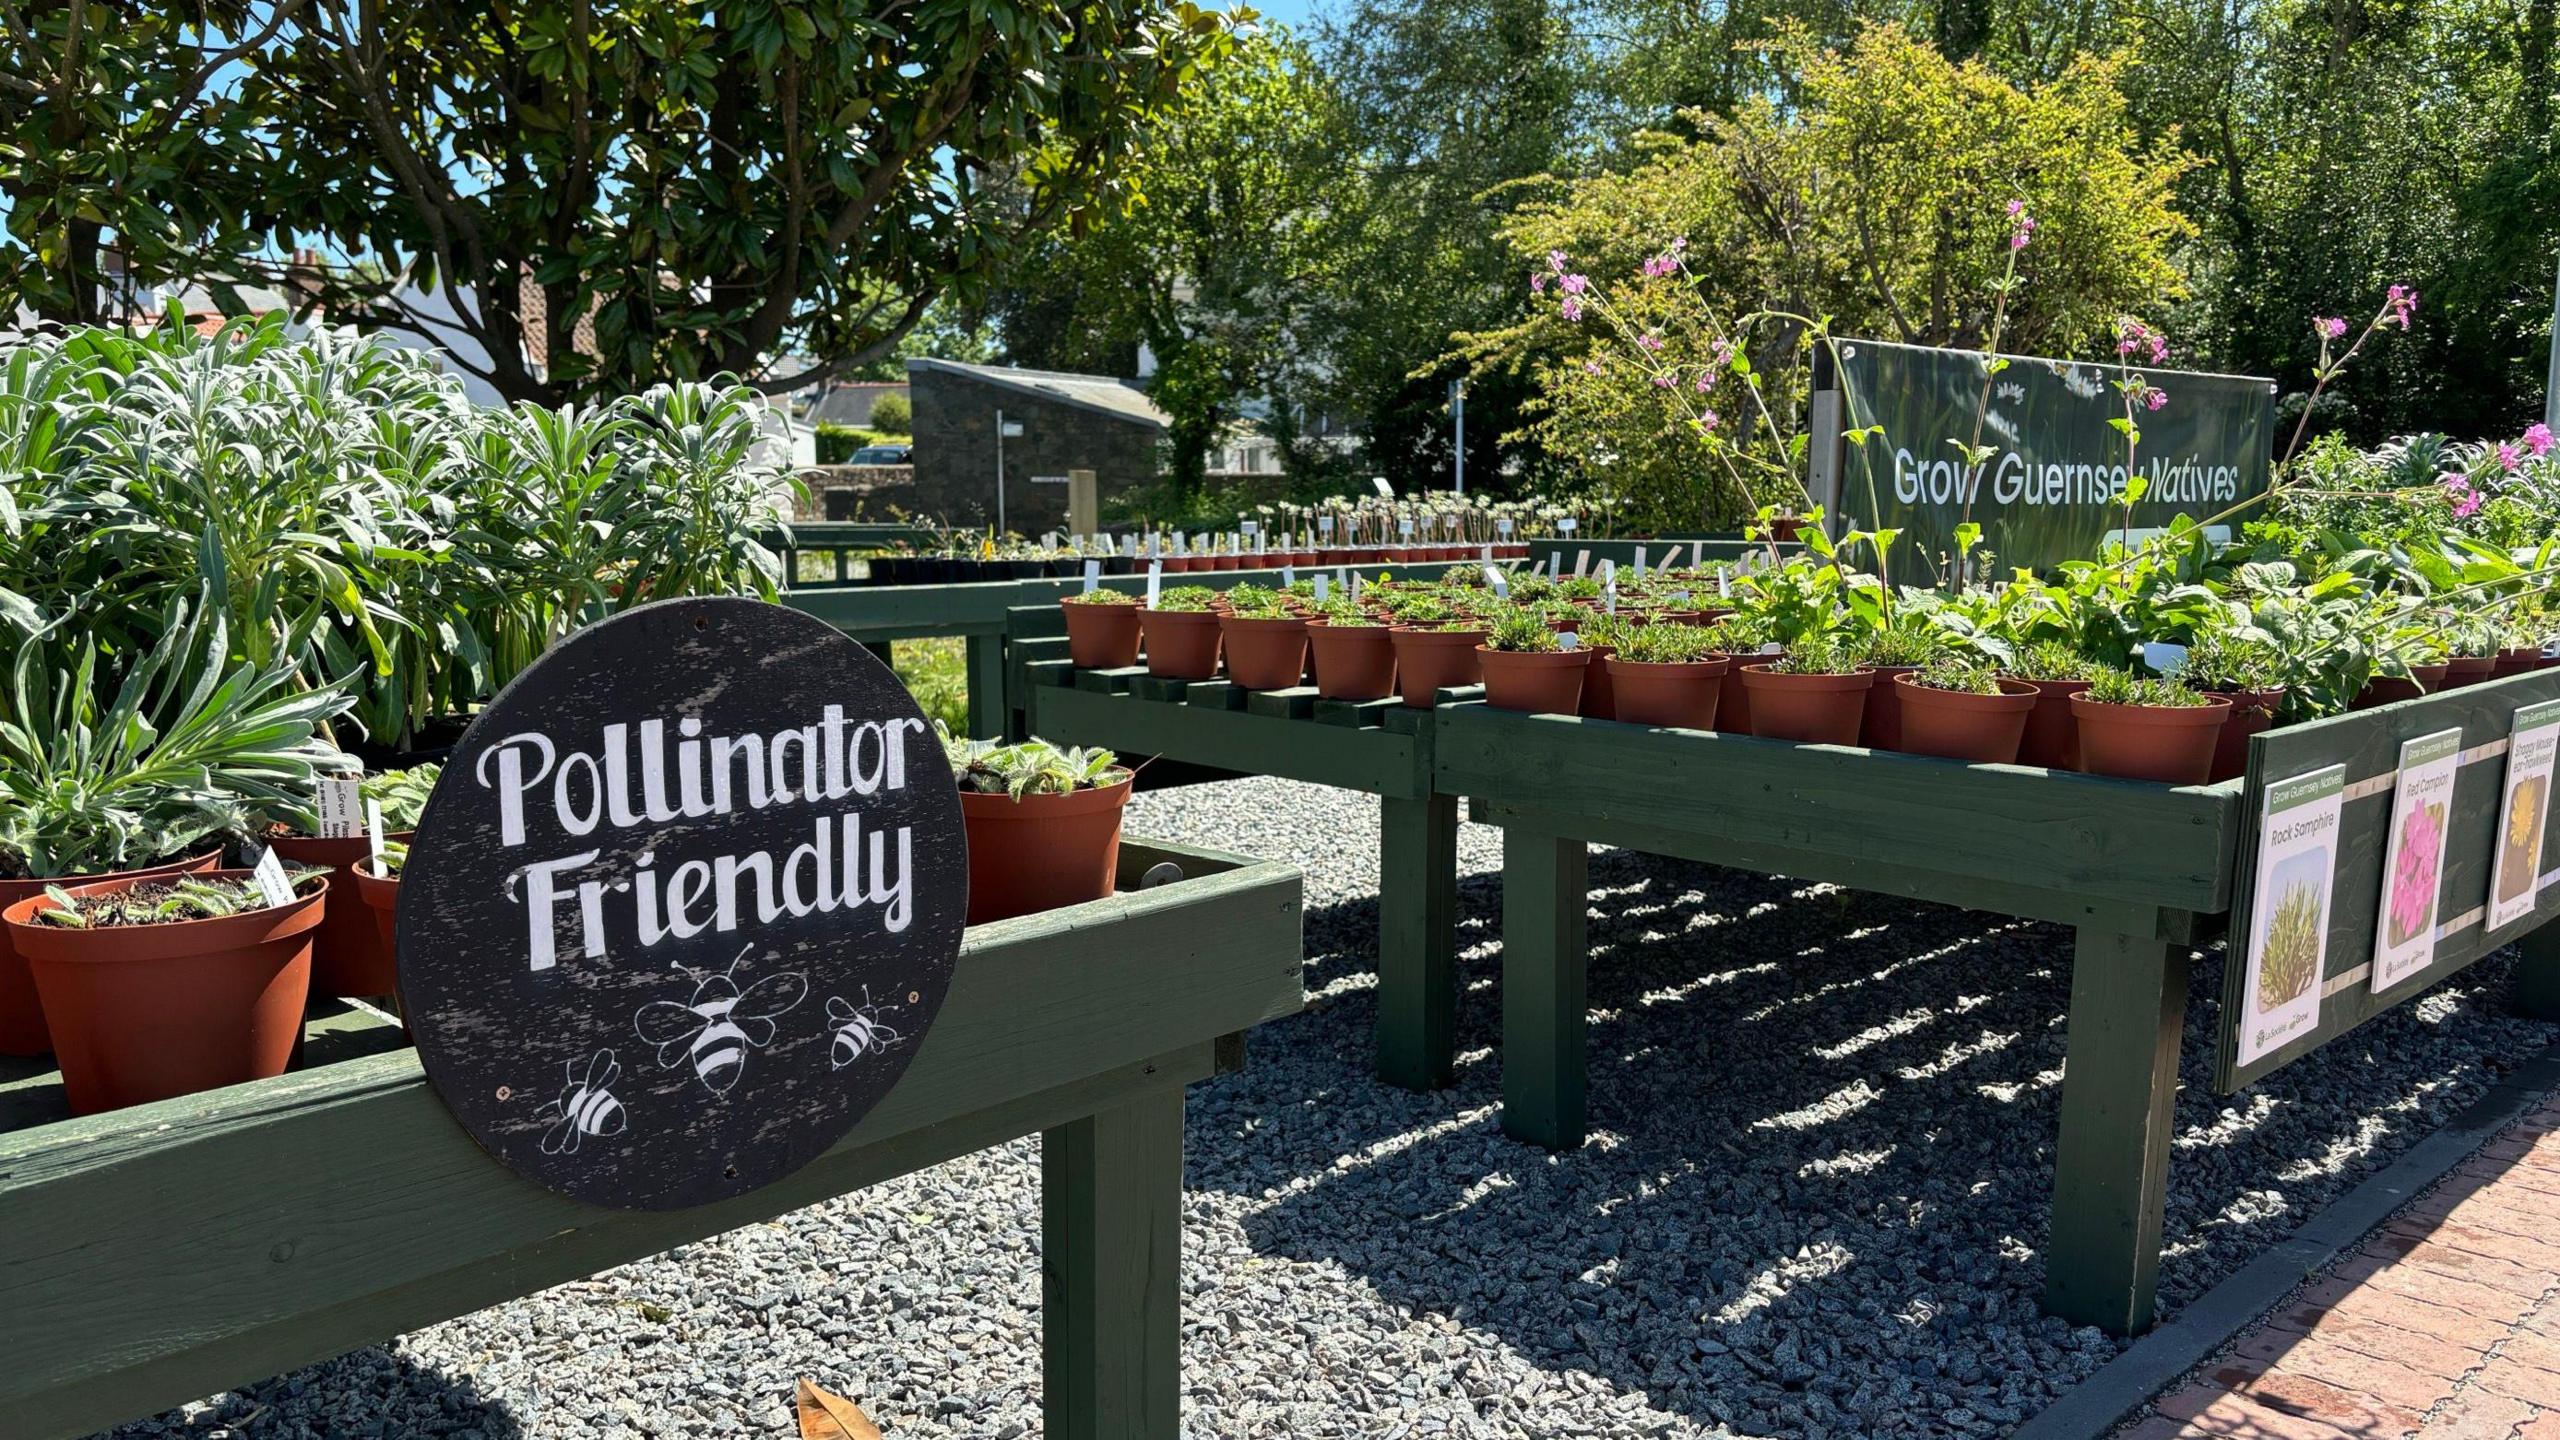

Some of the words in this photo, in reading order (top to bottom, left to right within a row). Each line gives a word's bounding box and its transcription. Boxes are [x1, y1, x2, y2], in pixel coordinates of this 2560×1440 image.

[1894, 447, 1988, 505] Grow
[1993, 451, 2145, 506] Guernse
[2144, 452, 2238, 504] Natives
[476, 704, 924, 846] Pollinator
[2273, 791, 2290, 805] Grow
[2290, 782, 2319, 798] Guernsey
[2320, 773, 2343, 789] Natives
[2406, 779, 2421, 799] Red
[2420, 771, 2449, 793] Campion
[337, 793, 346, 816] Grow
[2270, 824, 2294, 847] Rock
[2294, 811, 2335, 838] Samphire
[505, 812, 912, 972] Friendly
